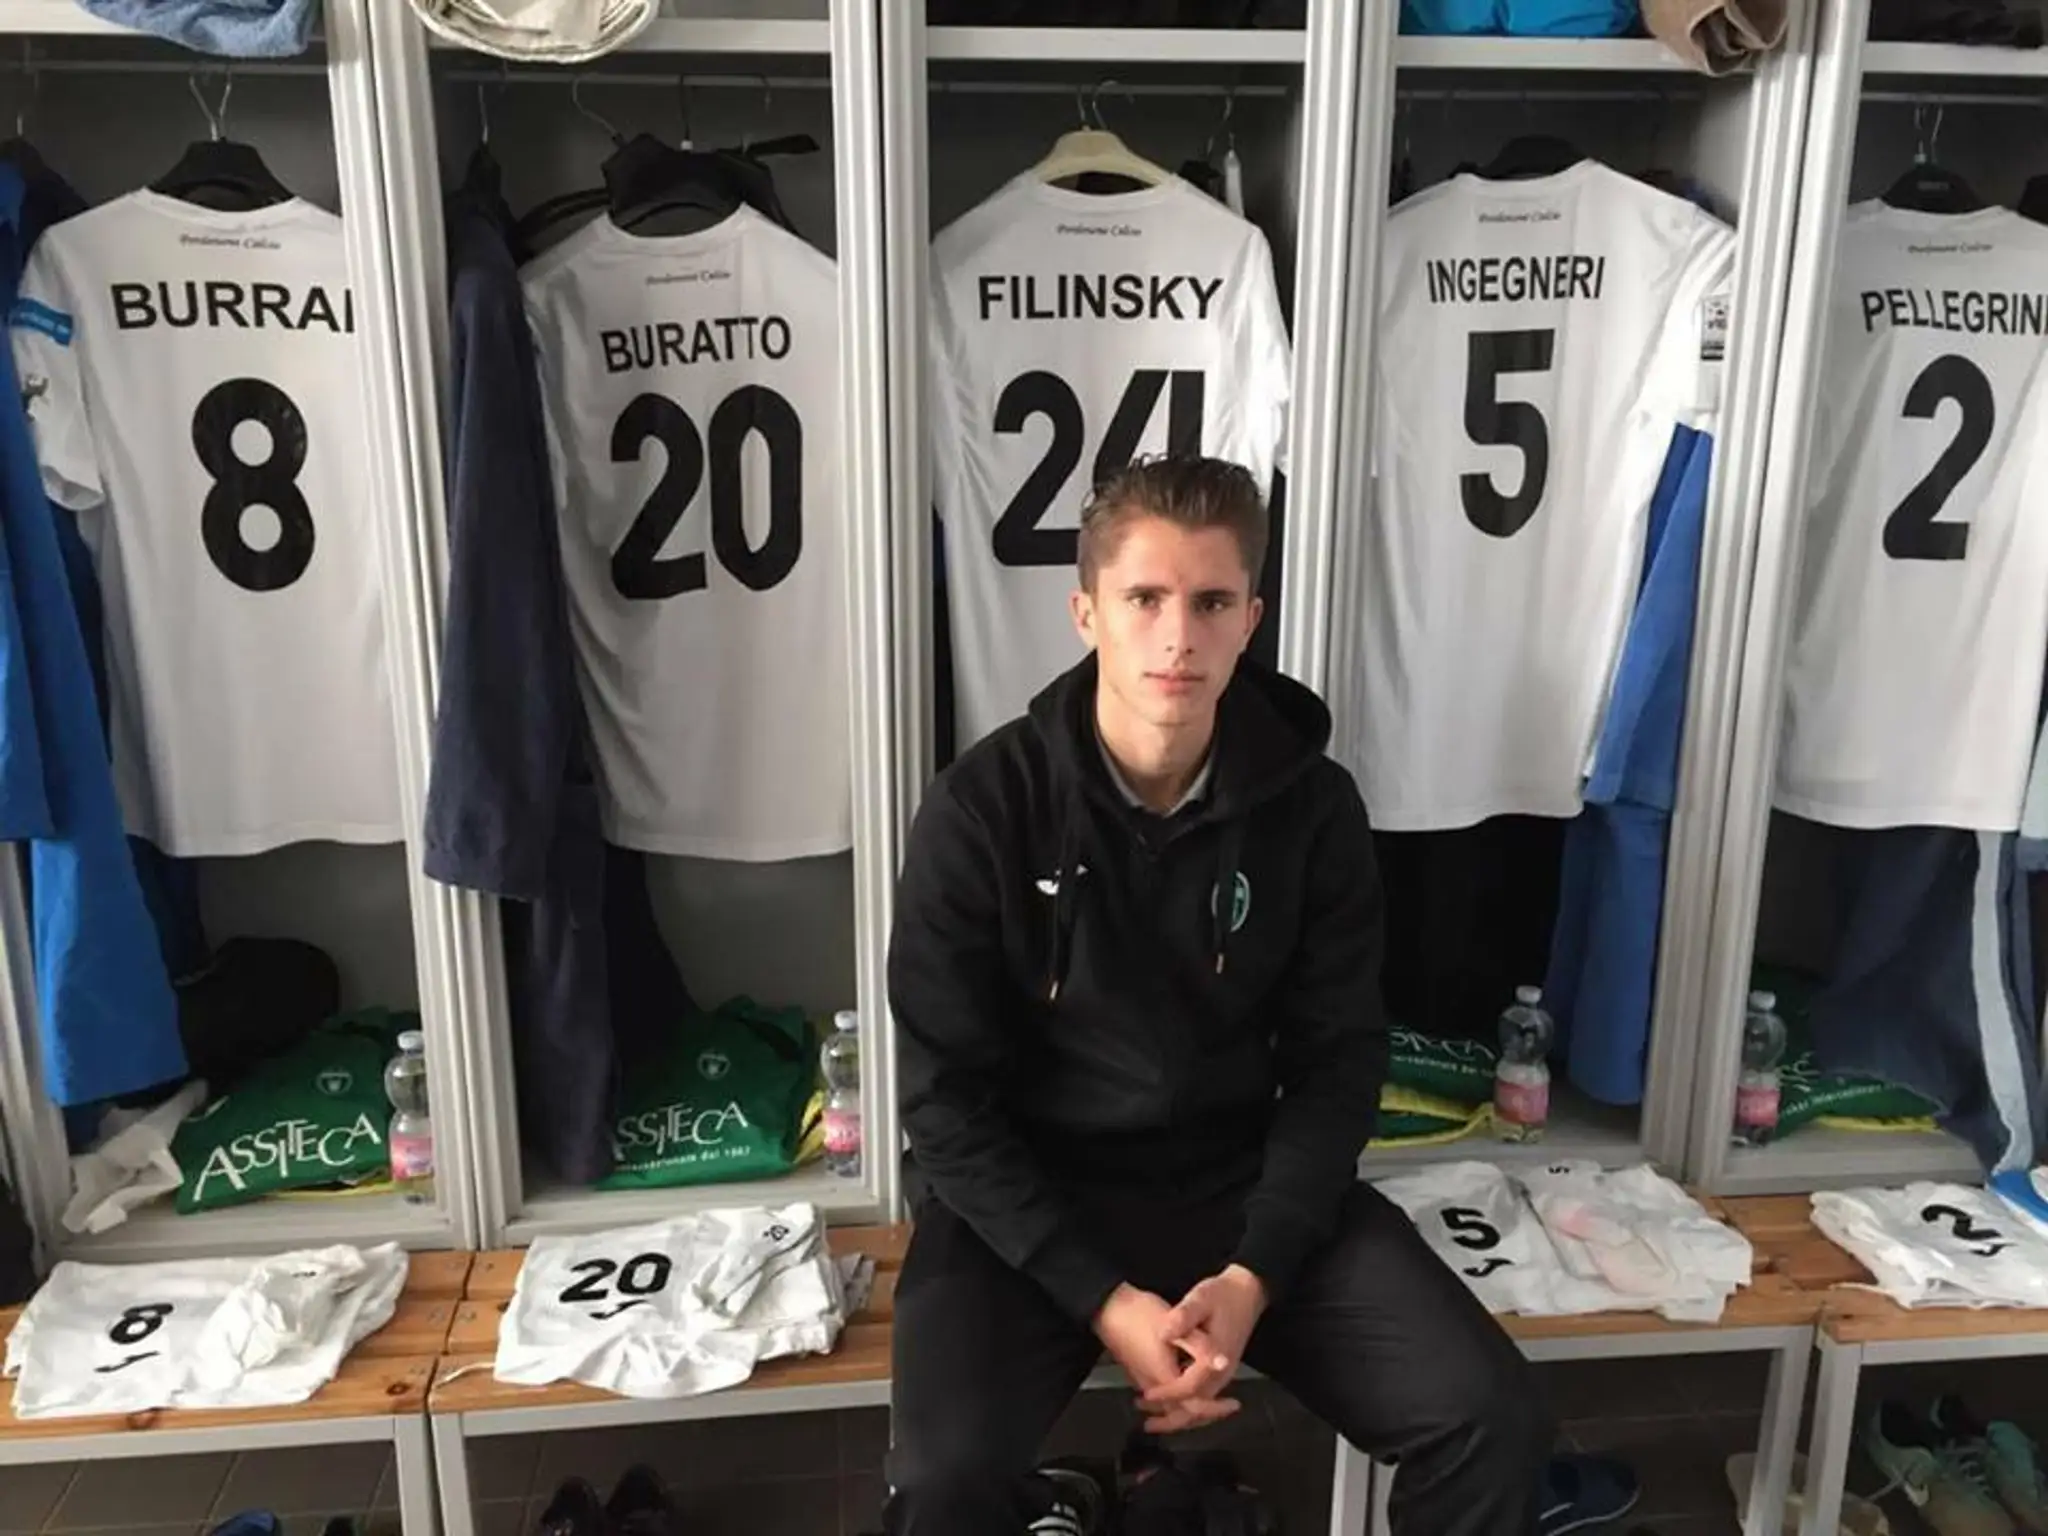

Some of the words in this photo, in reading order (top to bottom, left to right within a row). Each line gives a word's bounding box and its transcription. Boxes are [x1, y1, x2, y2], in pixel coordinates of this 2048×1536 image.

[979, 274, 1222, 320] FILINSKY
[1427, 256, 1604, 302] INGEGNERI
[1861, 289, 2048, 335] PELLEGRIN
[602, 316, 791, 373] BURATTO
[1461, 329, 1555, 537] 5
[1883, 355, 1995, 560] 2
[192, 378, 315, 592] 8
[611, 385, 802, 600] 20
[193, 1113, 382, 1202] ASSITECA
[1440, 1207, 1501, 1250] 5
[560, 1253, 672, 1303] 20
[110, 1303, 174, 1344] 8
